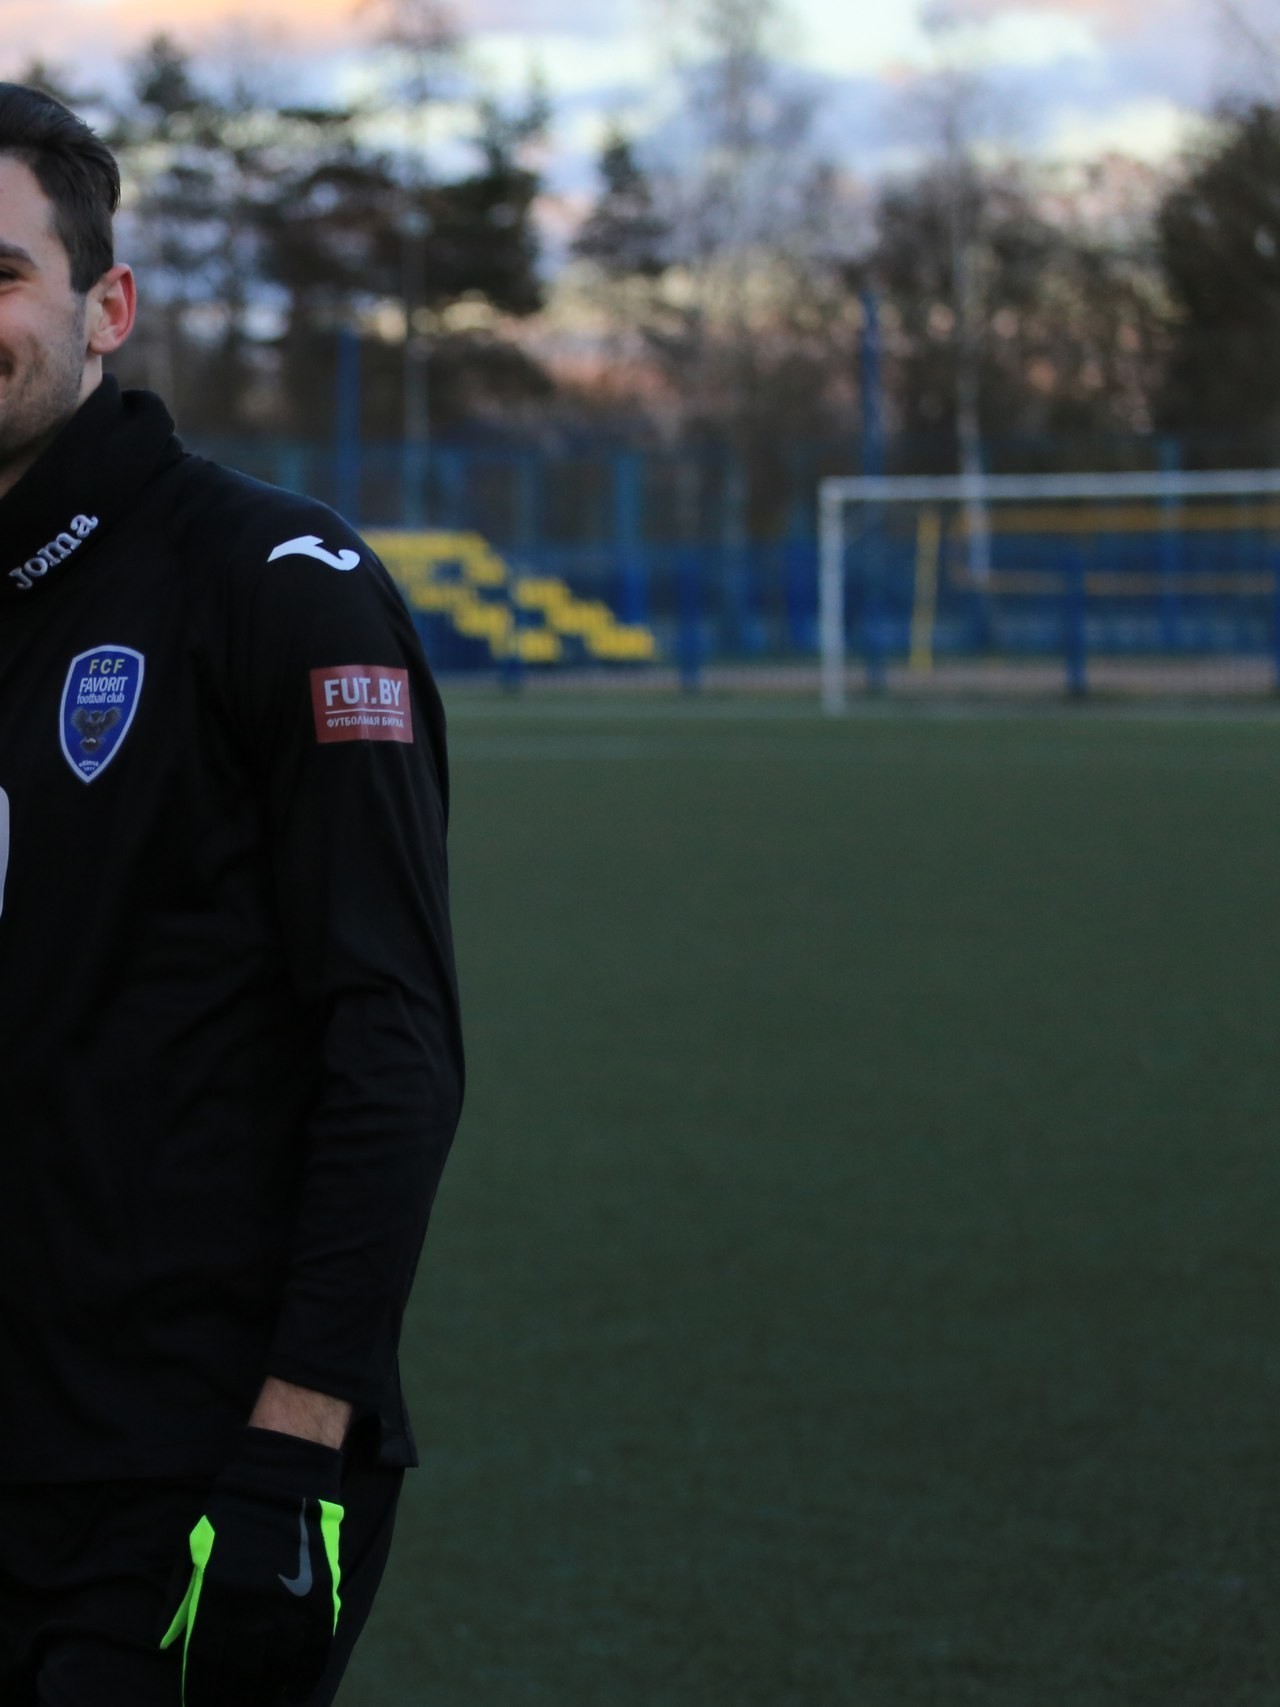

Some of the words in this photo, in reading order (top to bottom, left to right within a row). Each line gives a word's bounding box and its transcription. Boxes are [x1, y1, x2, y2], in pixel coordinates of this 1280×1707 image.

[89, 659, 125, 675] FCF
[79, 676, 128, 693] FAVORIT
[324, 677, 402, 707] FUT.BY
[77, 692, 107, 704] football
[107, 692, 125, 703] club
